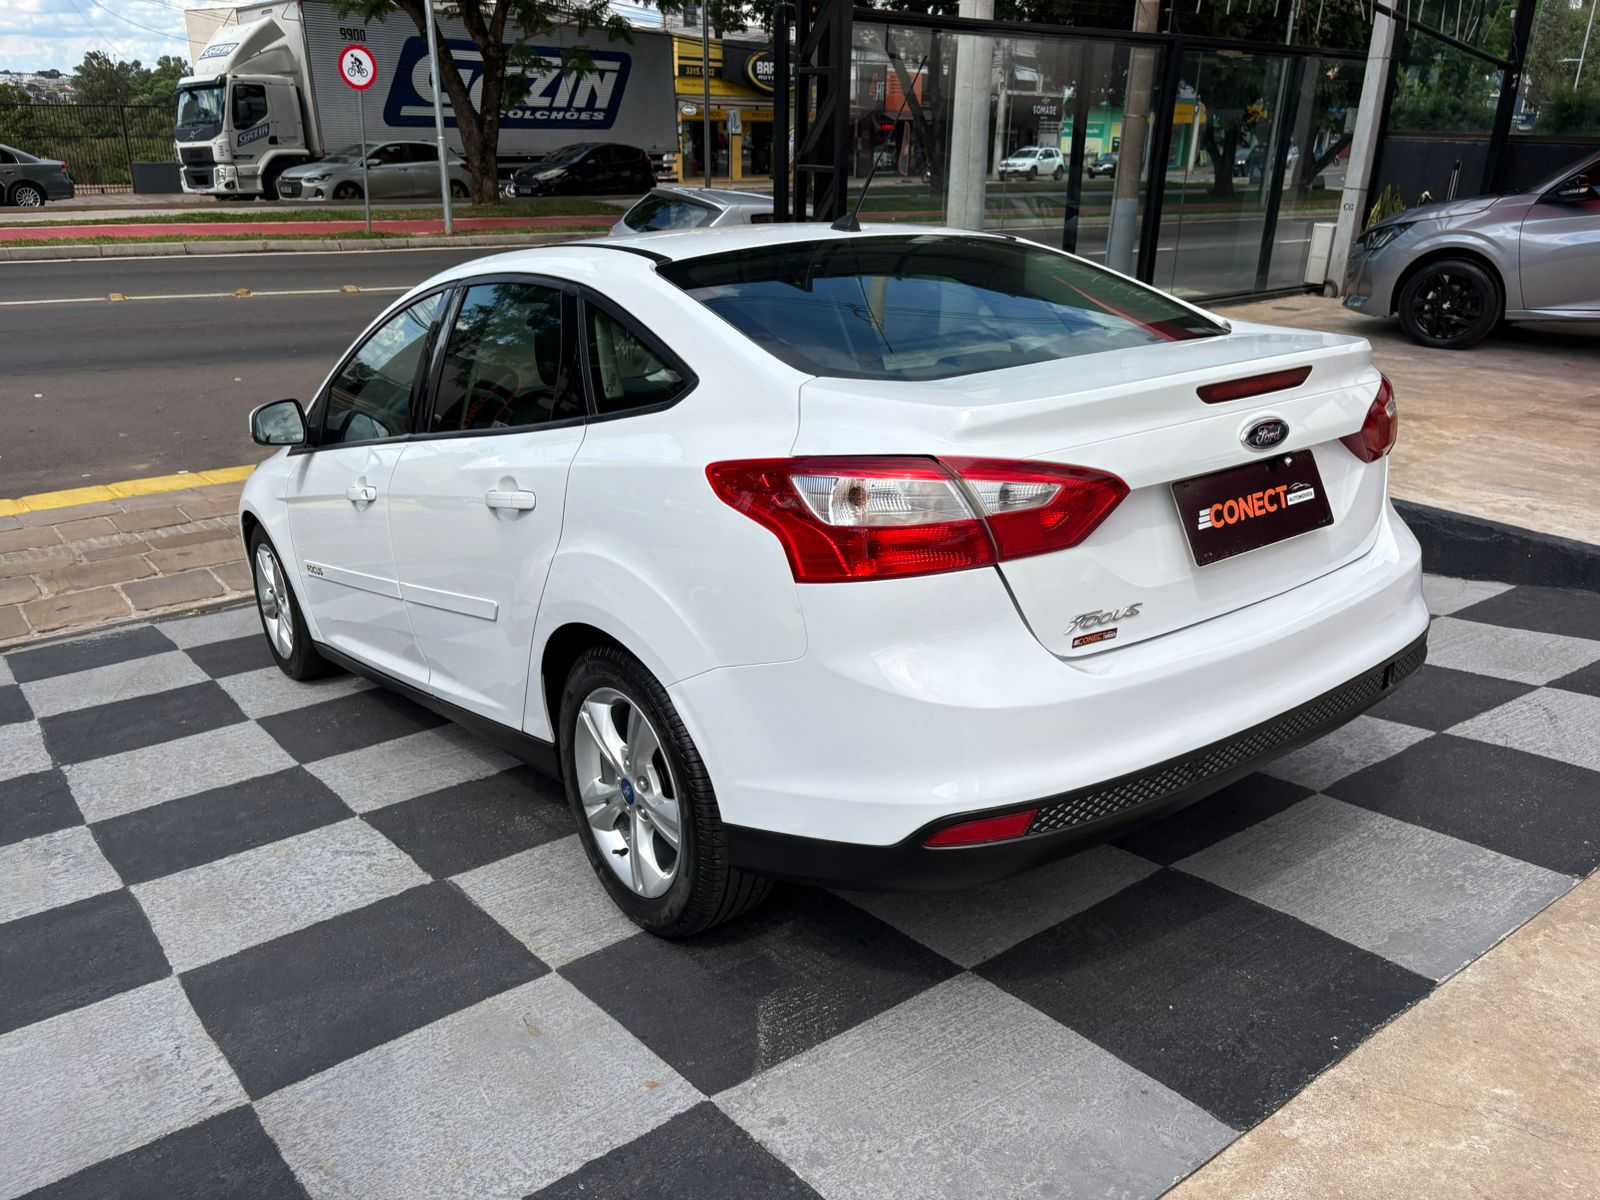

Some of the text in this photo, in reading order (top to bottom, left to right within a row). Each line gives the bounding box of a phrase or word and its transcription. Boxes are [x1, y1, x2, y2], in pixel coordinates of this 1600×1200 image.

[340, 27, 367, 41] 9900
[1256, 424, 1281, 445] Ford
[1209, 485, 1287, 529] CONECT
